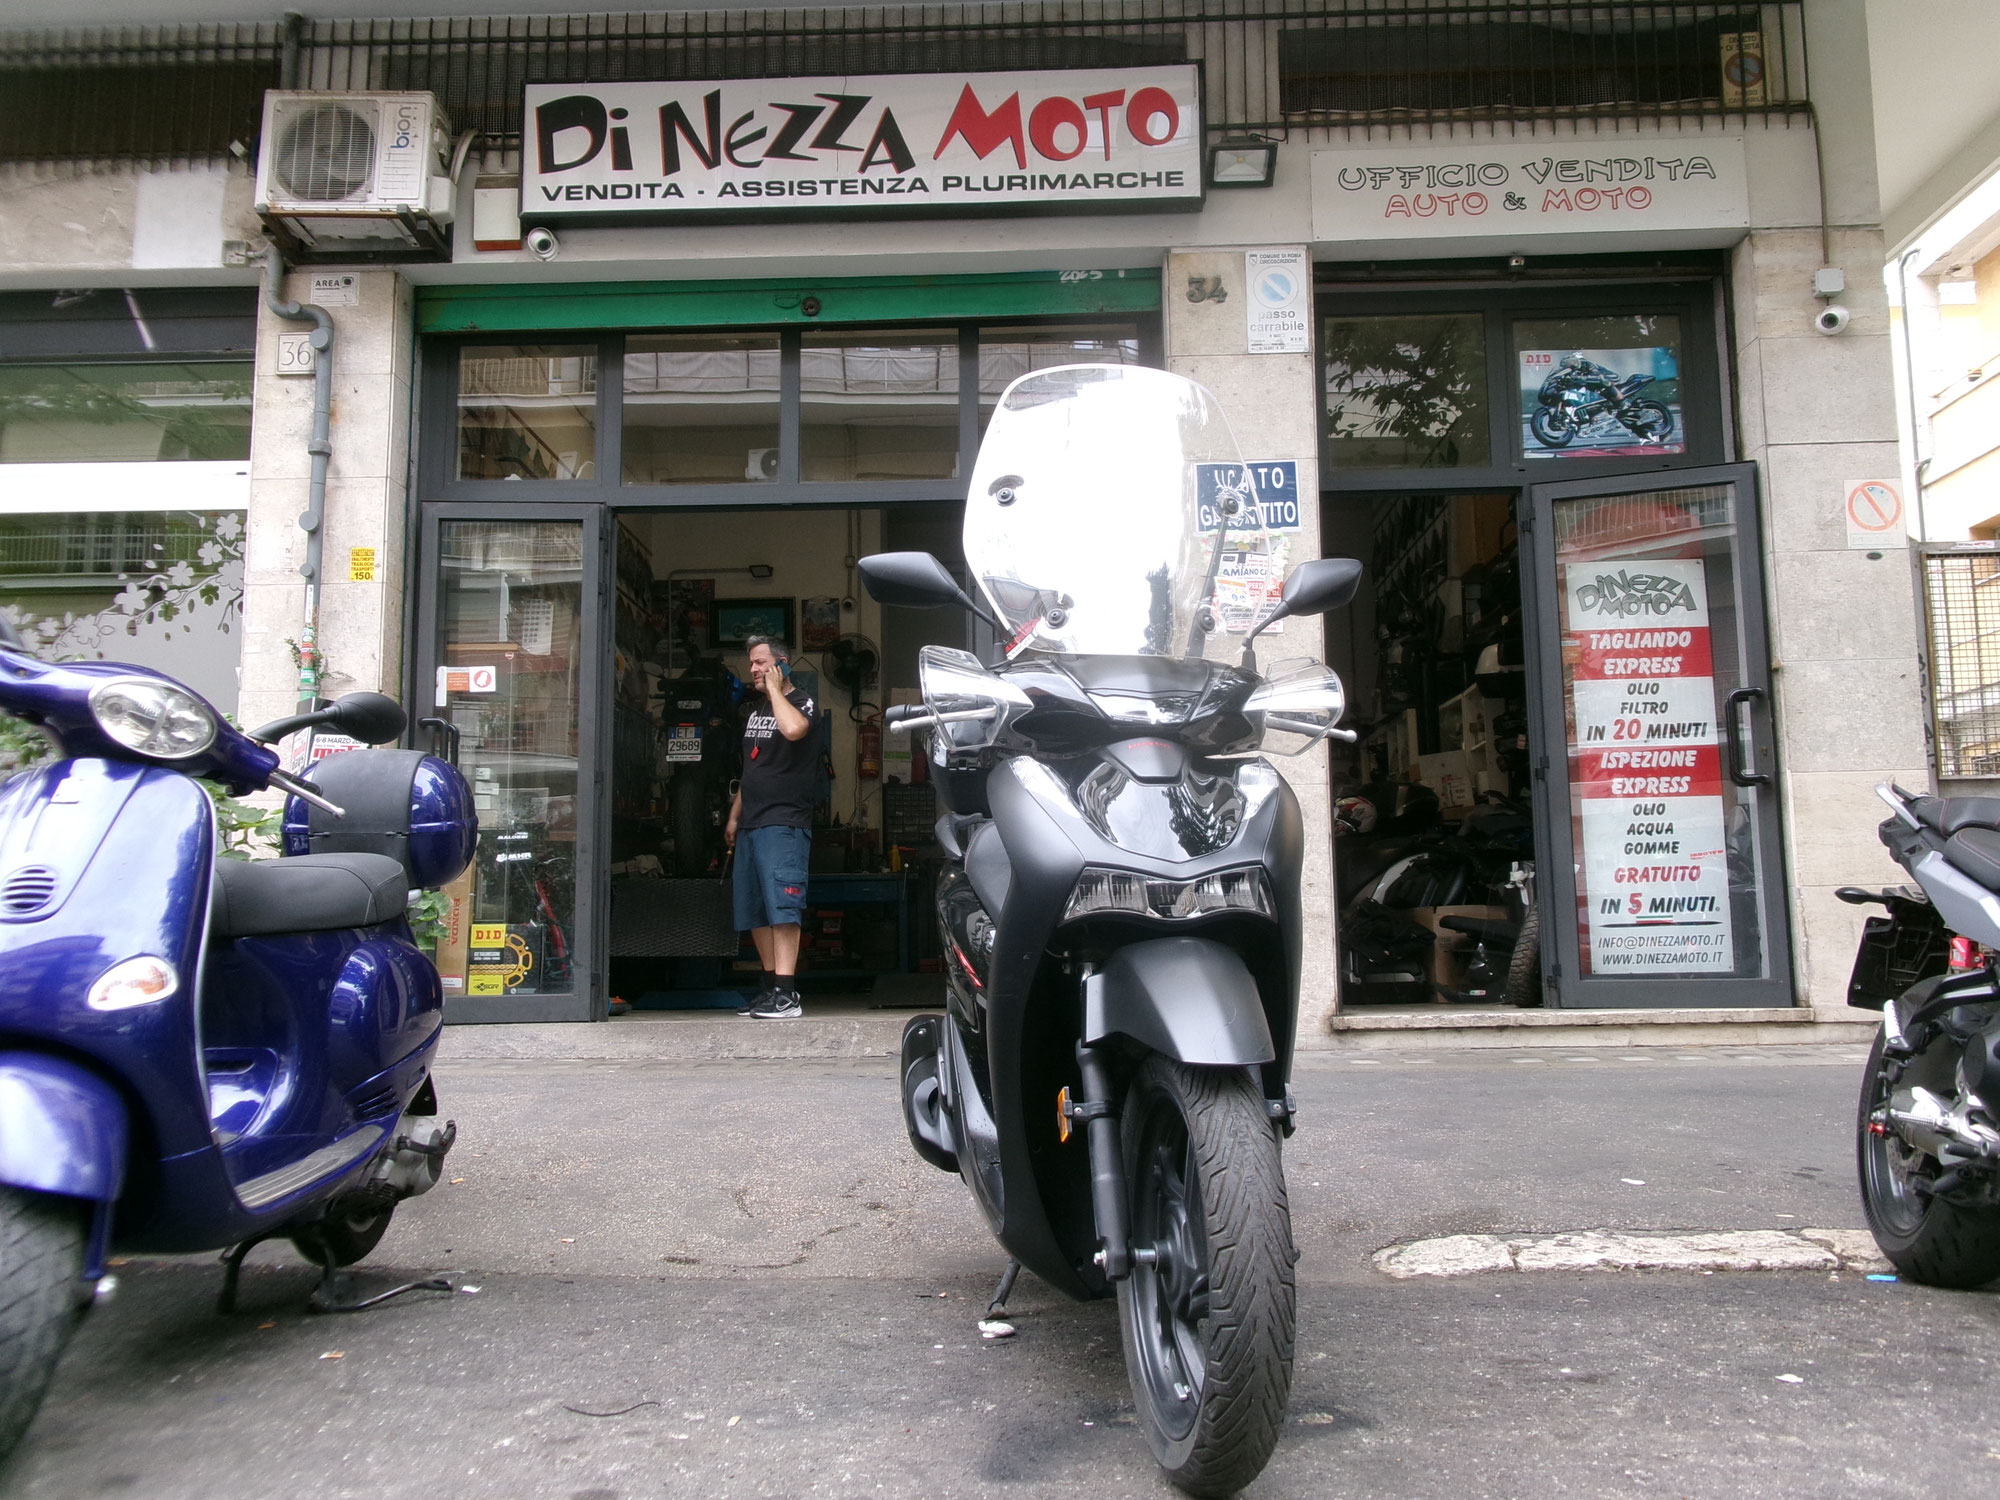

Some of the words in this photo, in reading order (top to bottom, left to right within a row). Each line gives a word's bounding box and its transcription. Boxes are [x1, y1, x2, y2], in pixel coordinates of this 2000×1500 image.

[932, 81, 1180, 170] MOTO
[1337, 162, 1510, 191] UFFICIO
[1521, 156, 1717, 185] VENDITA
[541, 181, 685, 201] VENDITA
[717, 177, 930, 198] ASSISTENZA
[942, 170, 1185, 192] PLURIMARCHE
[1385, 192, 1489, 218] AUTO
[1503, 191, 1527, 211] &
[1541, 186, 1653, 213] MOTO
[315, 279, 340, 287] AREA
[1258, 310, 1296, 322] passo
[1250, 320, 1305, 332] carrabile
[281, 340, 311, 366] 36
[1596, 593, 1672, 619] MOTO
[1589, 631, 1692, 650] TAGLIANDO
[1603, 656, 1682, 676] EXPRESS
[1627, 682, 1660, 696] OLIO
[1620, 701, 1669, 715] FILTRO
[677, 727, 689, 738] ET
[1586, 725, 1607, 741] IN
[1612, 718, 1642, 741] 20
[1646, 721, 1708, 740] MINUTI
[669, 740, 700, 751] 29689
[1601, 750, 1697, 769] ISPEZIONE
[1611, 775, 1691, 795] EXPRESS
[1632, 802, 1666, 817] OLIO
[1626, 822, 1674, 836] ACQUA
[1624, 841, 1680, 855] GOMME
[1614, 864, 1702, 885] GRATUITO
[1600, 898, 1622, 915] IN
[1627, 892, 1643, 915] 5
[475, 930, 502, 940] DID
[1598, 934, 1726, 949] INFO@DINEZZAMOTO.IT
[1602, 951, 1723, 966] WWW.DINEZZAMOTO.IT
